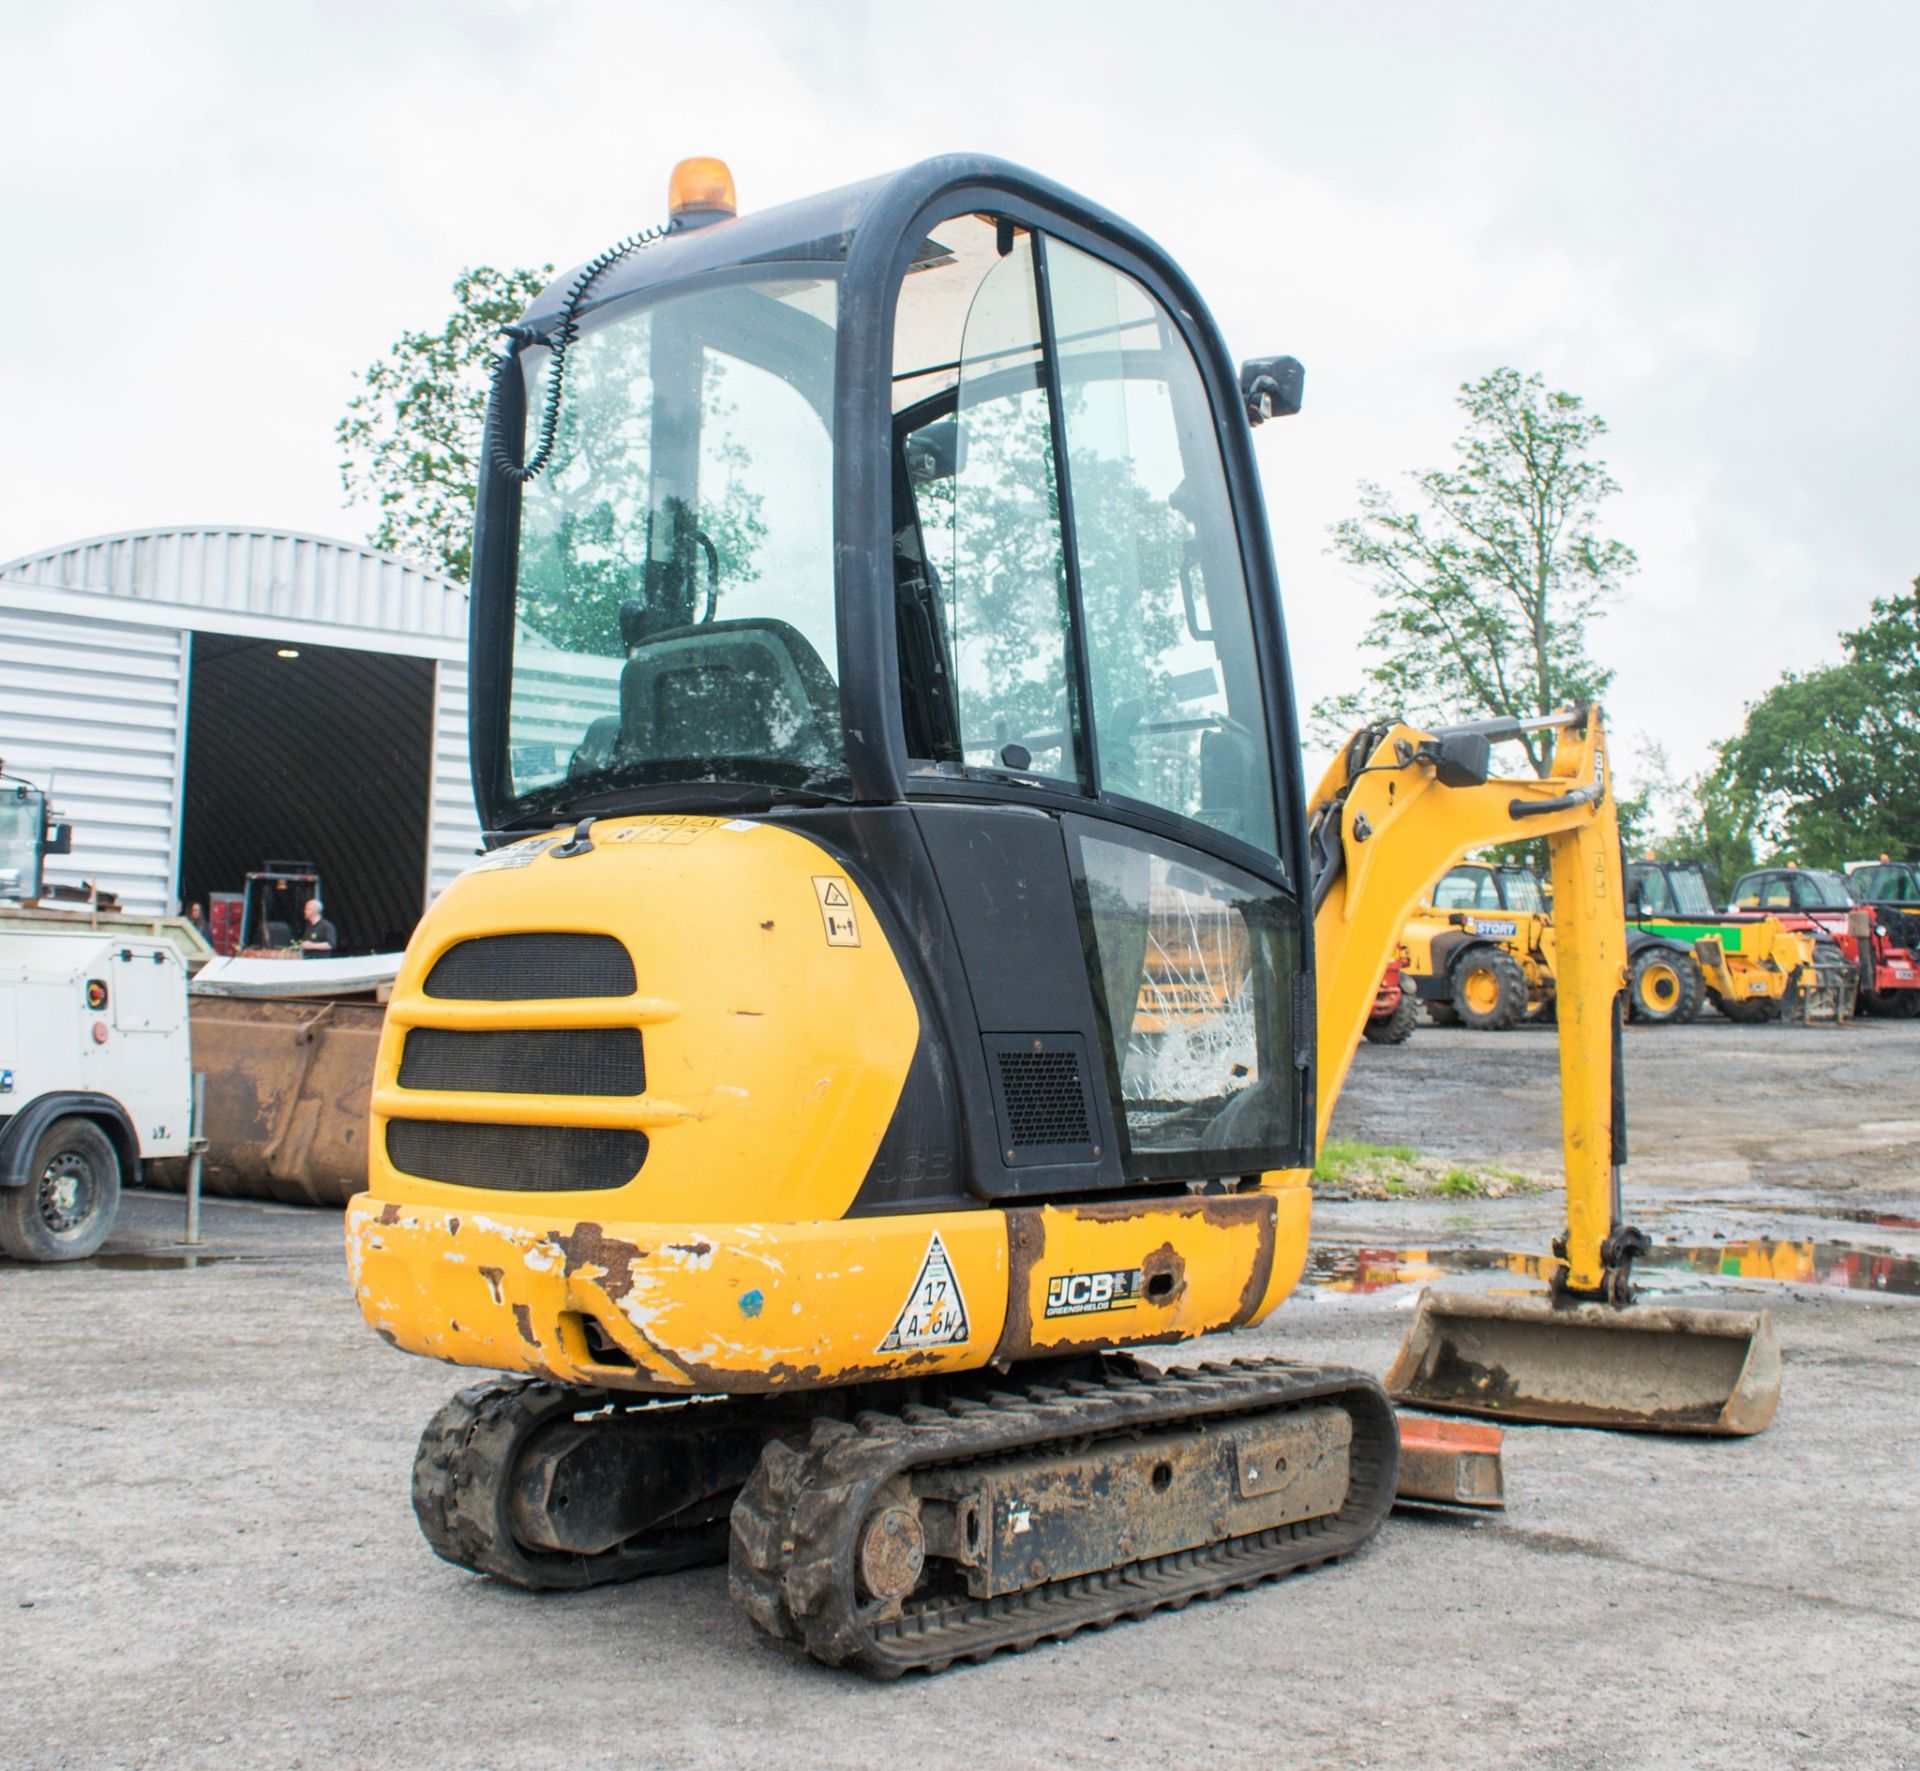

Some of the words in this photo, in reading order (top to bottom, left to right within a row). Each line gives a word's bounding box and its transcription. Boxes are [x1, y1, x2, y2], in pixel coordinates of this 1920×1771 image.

[1476, 921, 1516, 935] STORY
[923, 1281, 947, 1306] 17
[1048, 1273, 1113, 1308] JCB
[1046, 1301, 1110, 1317] GREENSHIELDS
